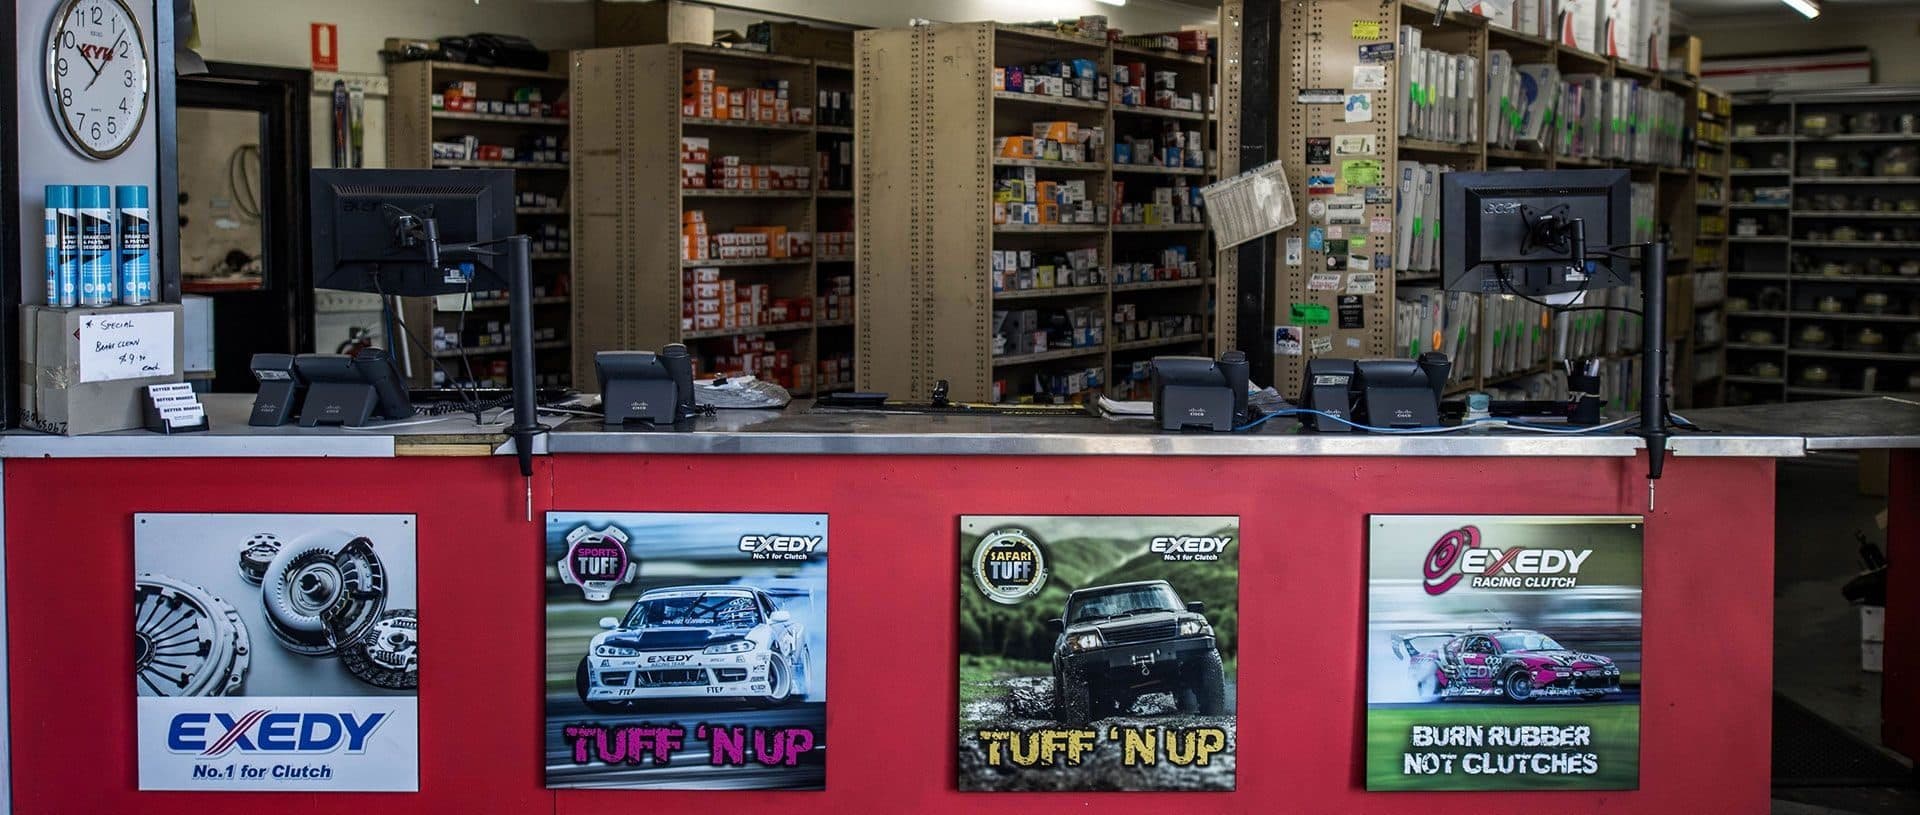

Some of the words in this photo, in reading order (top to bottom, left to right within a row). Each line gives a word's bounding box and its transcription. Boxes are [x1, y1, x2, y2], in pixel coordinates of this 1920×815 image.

[75, 10, 85, 27] 11
[91, 7, 103, 25] 12
[111, 18, 115, 33] 1
[62, 30, 75, 49] 10
[120, 41, 128, 58] 2
[58, 58, 68, 77] 9
[124, 70, 133, 88] 3
[63, 88, 72, 107] 8
[119, 98, 127, 114] 4
[76, 113, 85, 131] 7
[91, 122, 101, 140] 6
[107, 117, 116, 135] 5
[101, 320, 134, 330] SPECIAL
[578, 548, 618, 556] SPORTS
[741, 535, 820, 552] EXEDY
[1151, 536, 1231, 553] EXEDY
[991, 552, 1031, 560] SAFARI
[1461, 547, 1593, 576] EXEDY
[578, 557, 618, 574] TUFF
[990, 561, 1031, 579] TUFF
[1472, 577, 1521, 588] RACING
[1525, 577, 1576, 588] CLUTCH
[647, 655, 693, 663] EXEDY
[168, 709, 395, 756] EXEDY
[1412, 726, 1483, 747] BURN
[1488, 726, 1591, 747] RUBBER
[566, 727, 684, 763] TUFF
[754, 728, 815, 765] UP
[979, 730, 1095, 766] TUFF
[1165, 729, 1225, 765] UP
[193, 765, 234, 778] No.1
[241, 765, 267, 778] for
[272, 765, 331, 778] Clutch
[1404, 752, 1457, 774] NOT
[1462, 752, 1599, 774] CLUTCHES
